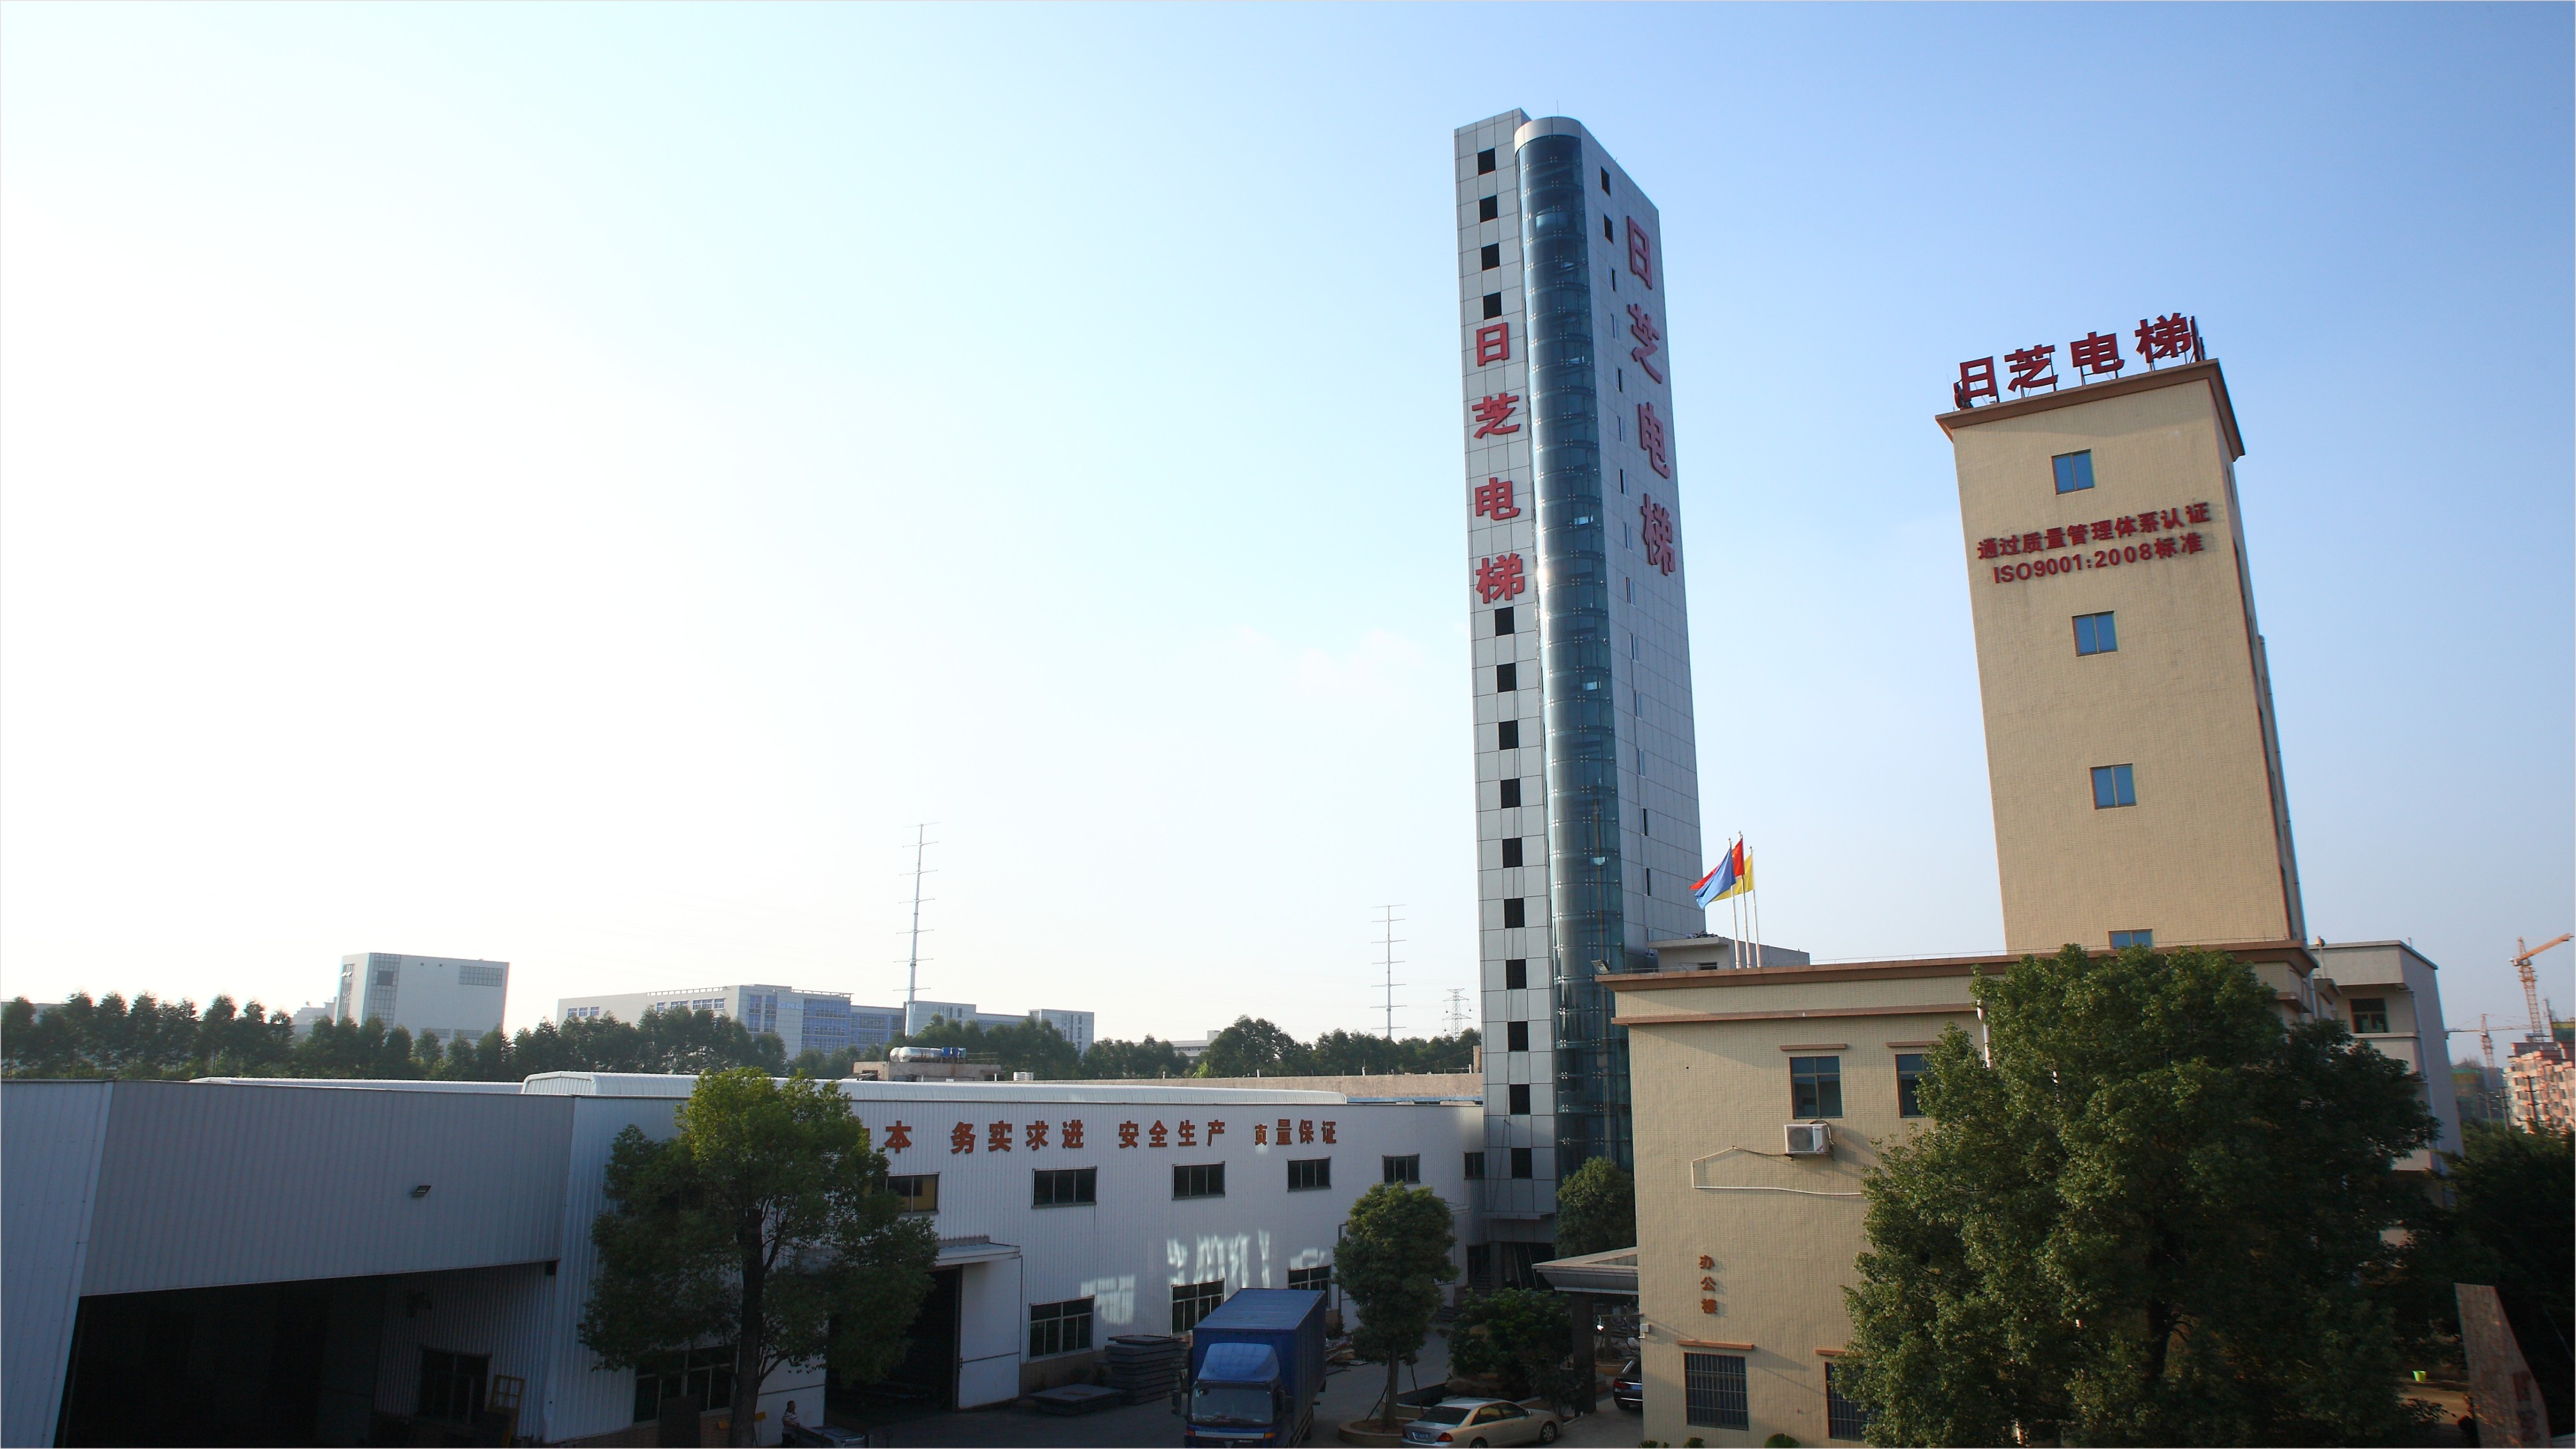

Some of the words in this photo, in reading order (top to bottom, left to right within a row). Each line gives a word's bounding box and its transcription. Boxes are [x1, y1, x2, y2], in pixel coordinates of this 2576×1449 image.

[1959, 312, 2191, 399] 日芝电梯
[1627, 215, 1676, 576] 日芝电梯
[1471, 321, 1525, 604] 日芝电梯
[1977, 502, 2212, 560] 通过质量管理体系认证
[1993, 532, 2204, 584] ISO9001:2008标准
[951, 1119, 1085, 1154] 务实求进
[1118, 1119, 1226, 1148] 安全生产
[1699, 1254, 1717, 1314] 办公楼
